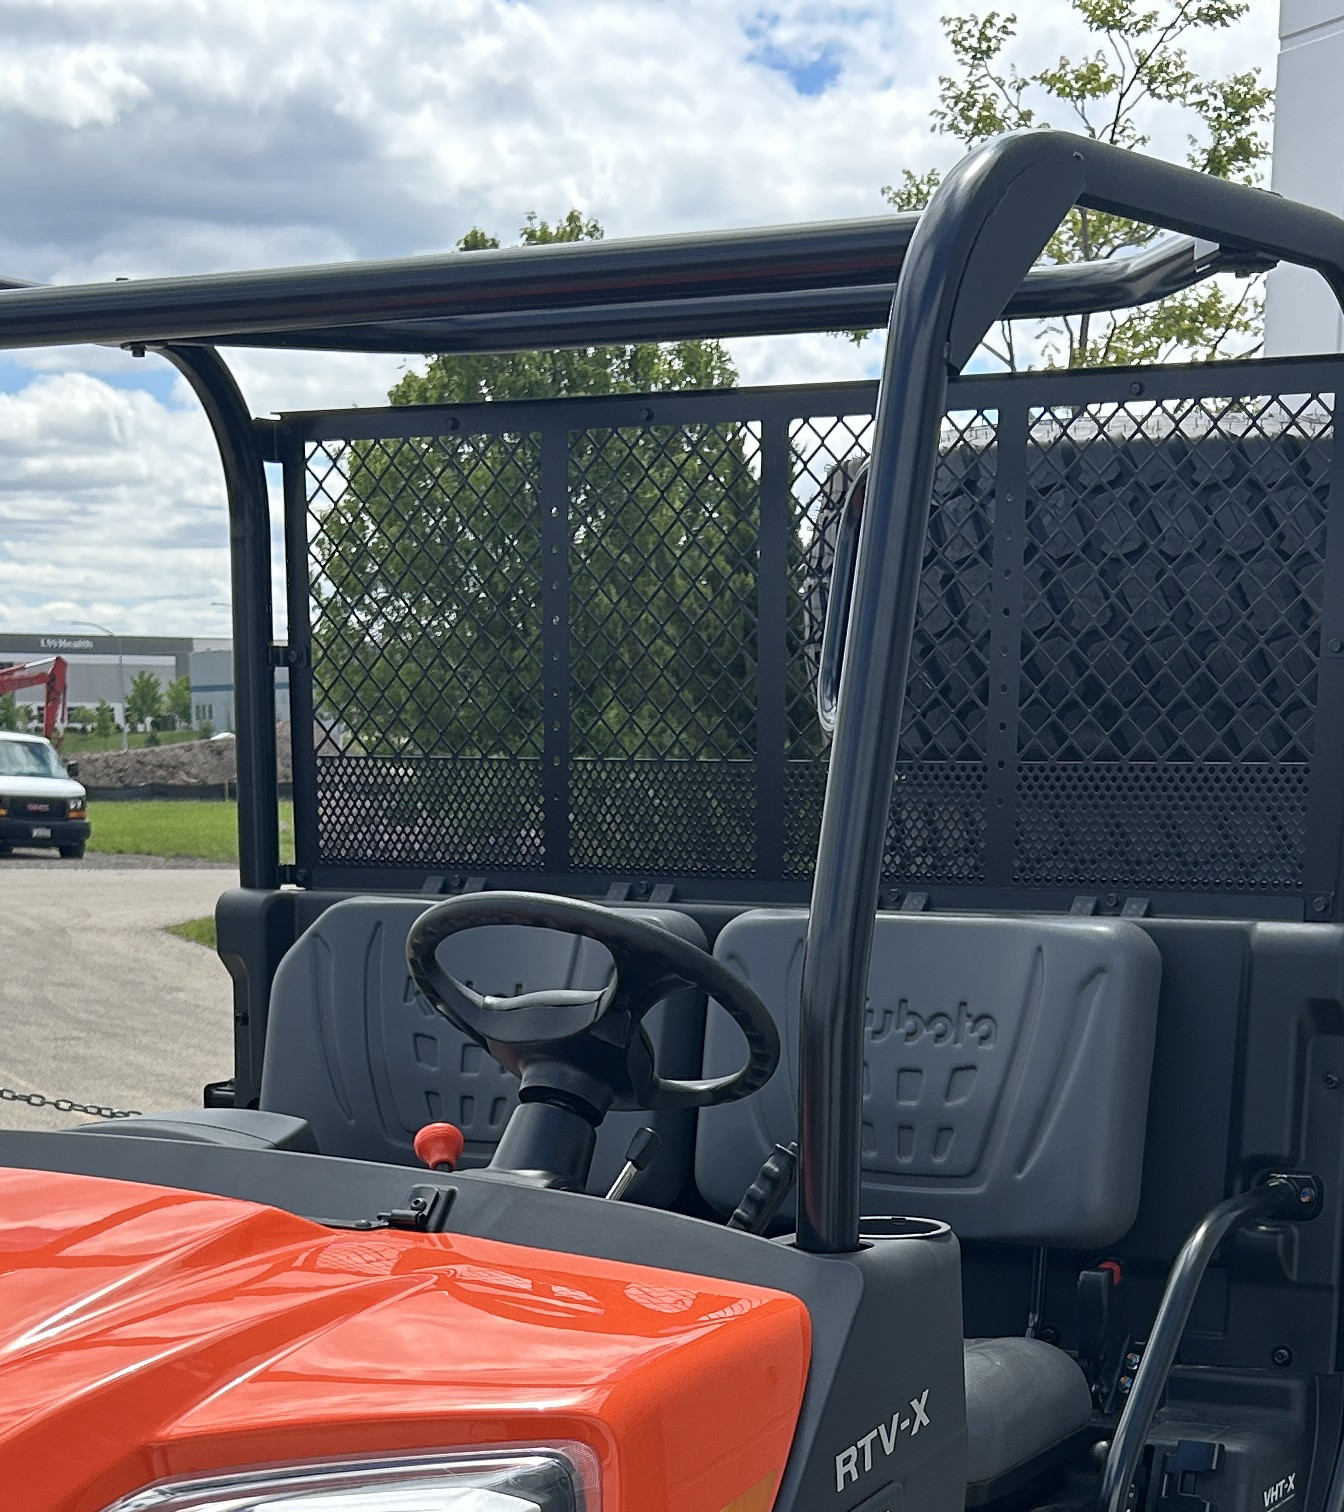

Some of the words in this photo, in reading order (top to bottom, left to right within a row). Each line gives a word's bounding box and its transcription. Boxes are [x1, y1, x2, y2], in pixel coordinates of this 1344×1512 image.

[865, 996, 998, 1050] ubota
[835, 1389, 930, 1493] RTV-X
[1264, 1472, 1296, 1507] VHT-X
